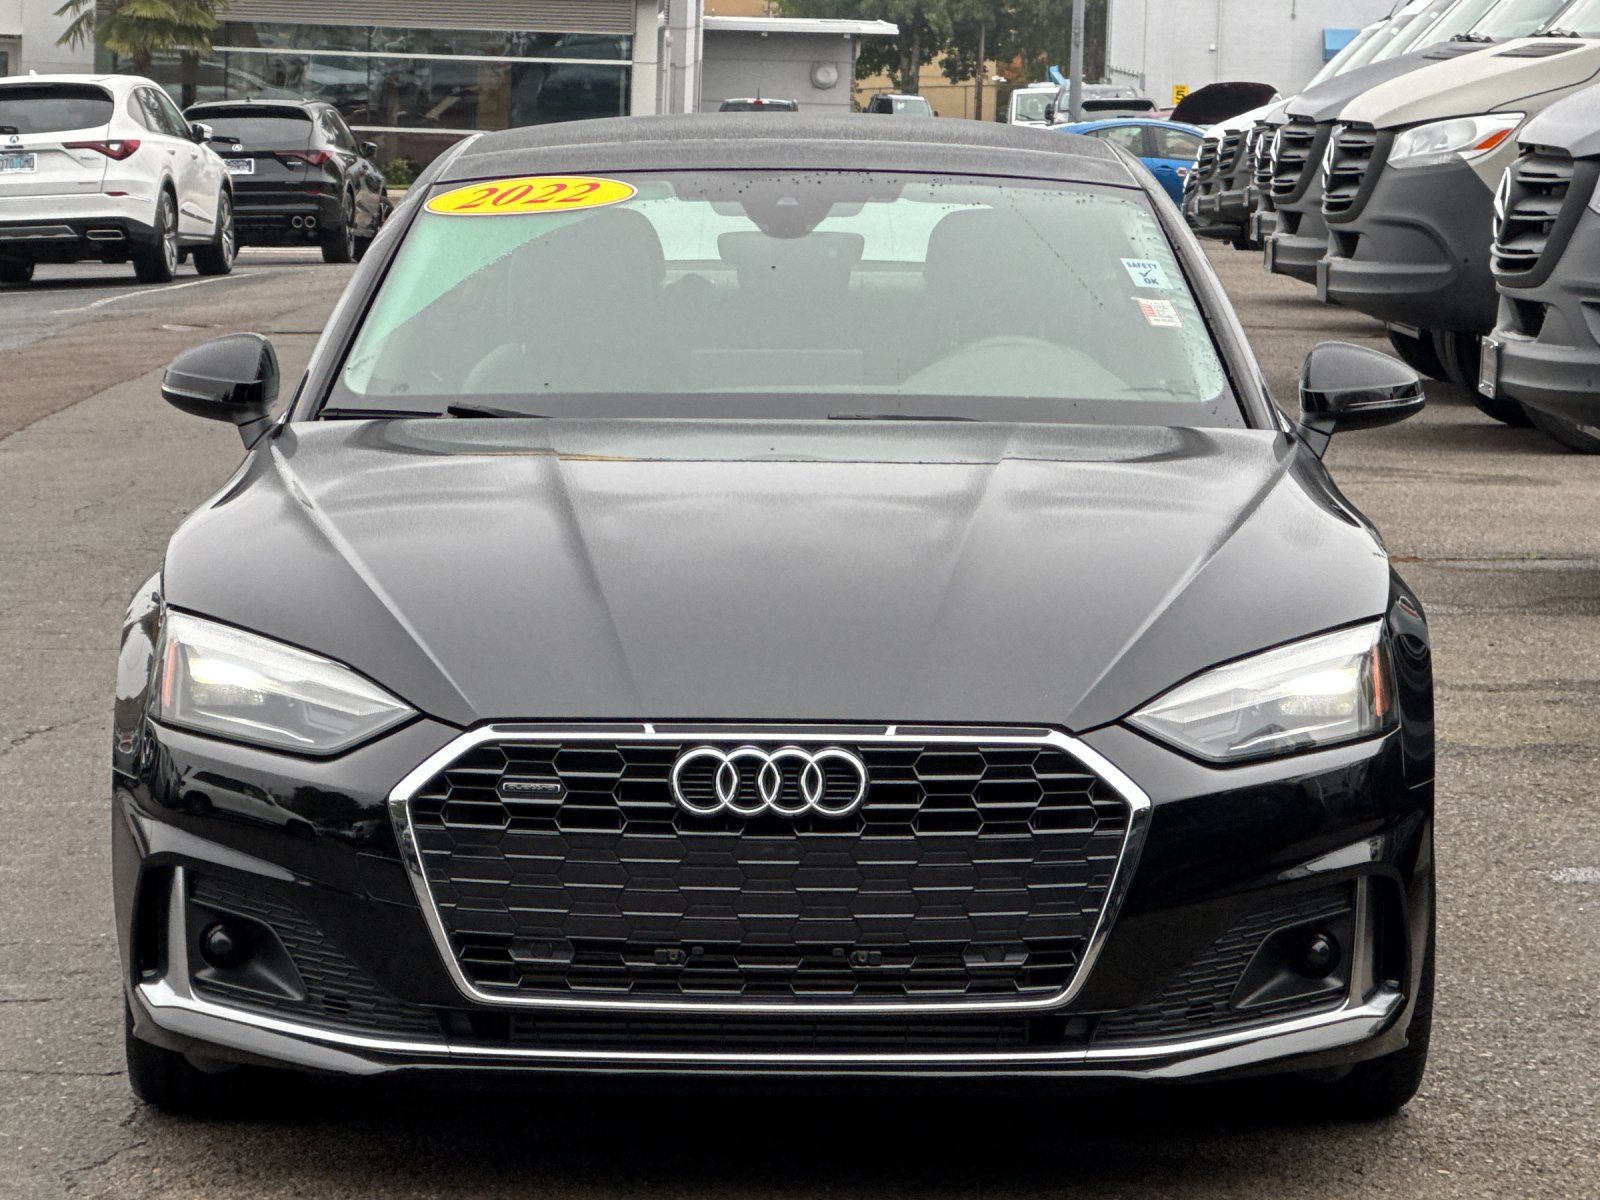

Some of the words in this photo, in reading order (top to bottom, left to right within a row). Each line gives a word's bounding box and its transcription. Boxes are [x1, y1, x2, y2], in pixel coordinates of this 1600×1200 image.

[453, 182, 601, 210] 2022
[1126, 261, 1157, 270] SAFETY
[1143, 277, 1159, 286] OK
